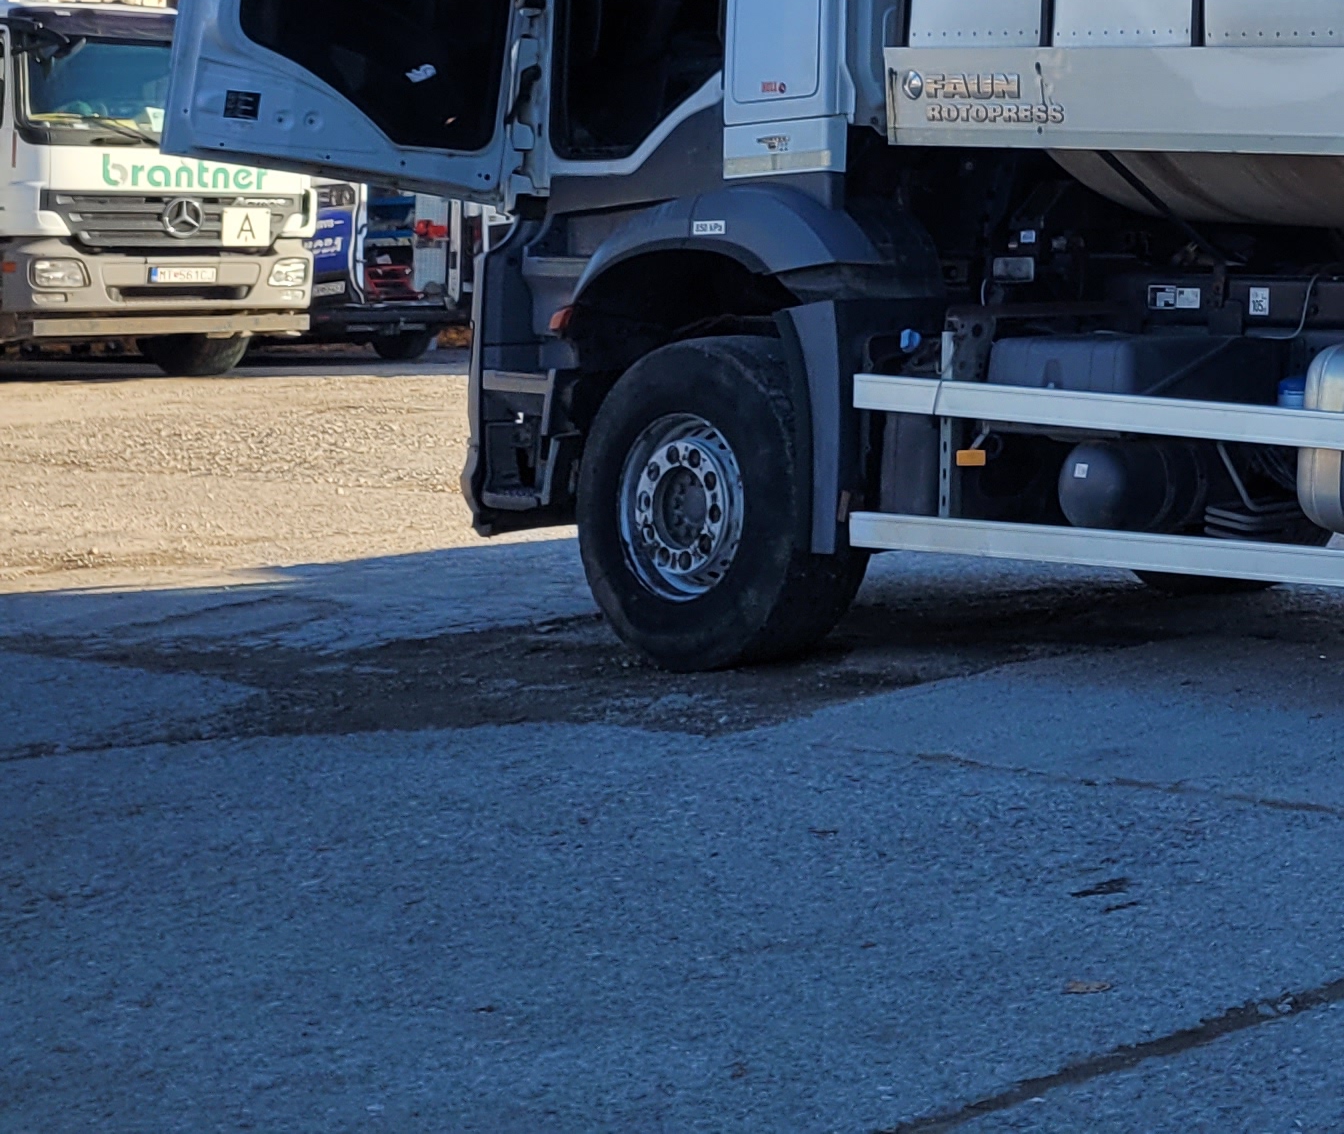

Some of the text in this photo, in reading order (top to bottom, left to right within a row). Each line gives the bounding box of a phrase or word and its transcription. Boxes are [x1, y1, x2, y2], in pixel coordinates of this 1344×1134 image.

[925, 73, 1021, 99] FAUN
[926, 103, 1065, 123] ROTOPRESS
[103, 153, 268, 190] brantner
[237, 213, 256, 240] A
